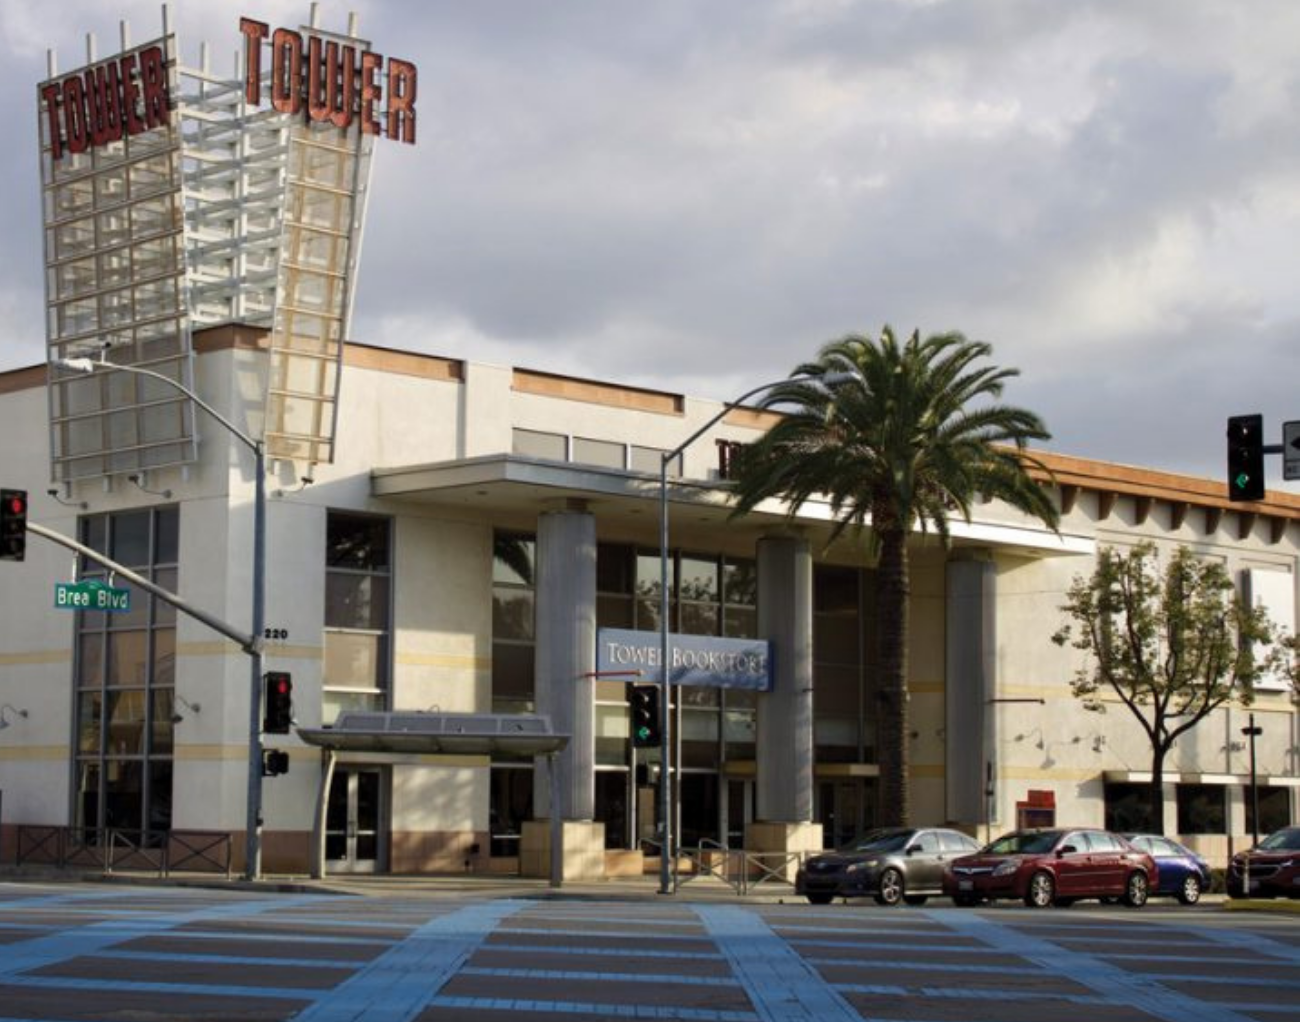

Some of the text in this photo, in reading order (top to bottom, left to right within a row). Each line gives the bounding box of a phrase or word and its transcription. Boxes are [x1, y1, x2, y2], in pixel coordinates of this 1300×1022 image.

[240, 16, 417, 145] TOWER
[41, 45, 171, 160] TOWER
[57, 586, 129, 609] Brea Blvd
[264, 628, 289, 640] 220
[672, 646, 765, 675] BOOKSTORE
